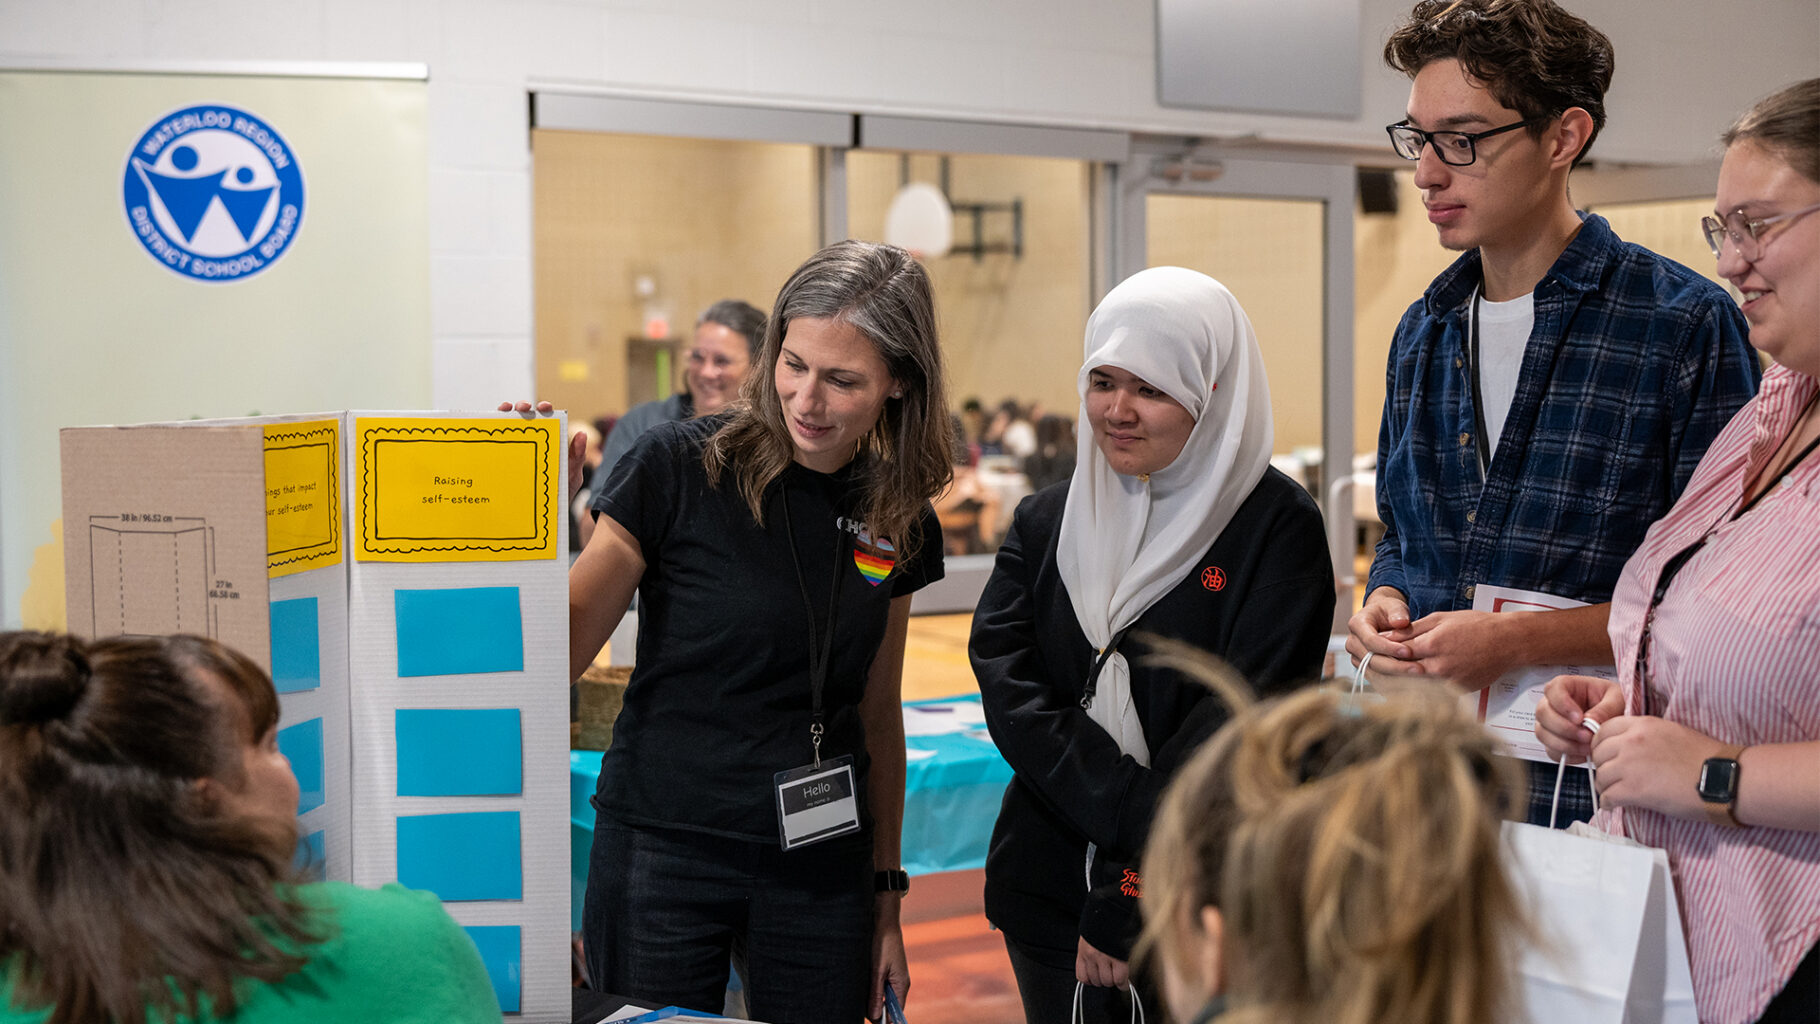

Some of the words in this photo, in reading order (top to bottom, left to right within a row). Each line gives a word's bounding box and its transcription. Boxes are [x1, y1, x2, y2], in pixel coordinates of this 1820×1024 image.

[142, 110, 231, 155] WATERLOO
[233, 116, 290, 169] REGION
[131, 205, 191, 269] DISTRICT
[190, 254, 264, 277] SCHOOL
[259, 204, 298, 258] BOARD
[283, 484, 296, 494] that
[298, 481, 317, 494] impact
[434, 476, 473, 488] Raising
[422, 494, 490, 504] self-esteem
[277, 503, 314, 515] self-esteem
[121, 514, 130, 522] 38
[131, 513, 138, 522] in
[143, 514, 161, 522] 96.52
[803, 783, 830, 798] Hello
